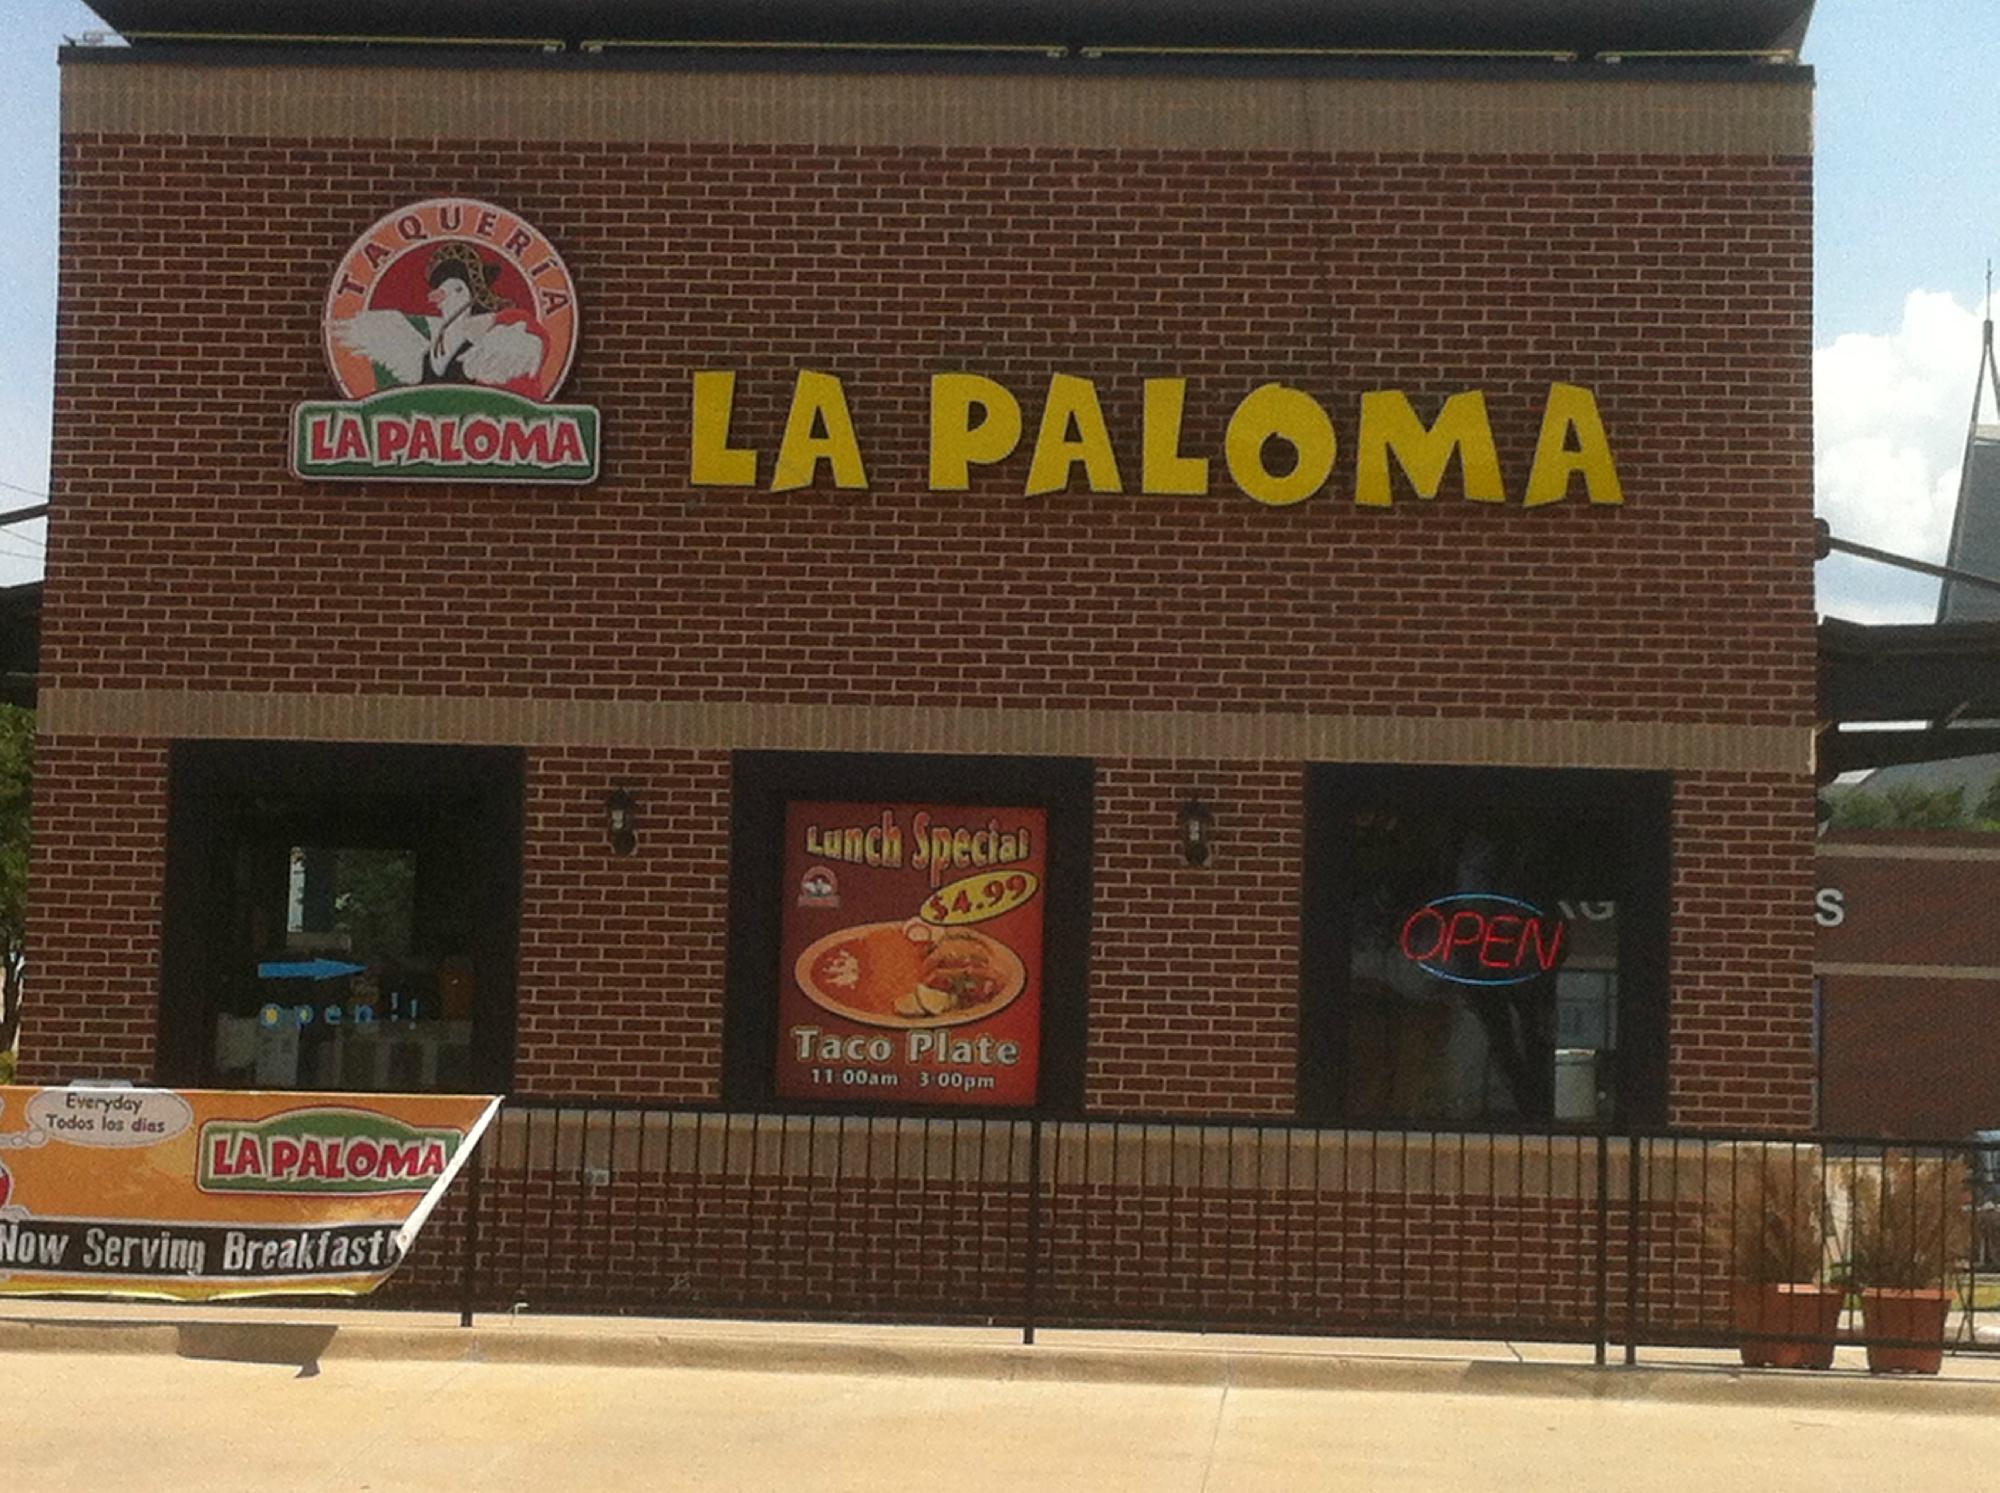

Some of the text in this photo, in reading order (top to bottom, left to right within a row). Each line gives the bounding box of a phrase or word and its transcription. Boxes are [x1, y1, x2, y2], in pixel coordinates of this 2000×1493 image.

[309, 415, 587, 466] LA PALOMA
[691, 370, 1624, 507] LA PALOMA
[806, 809, 1030, 888] Lunch Special
[929, 874, 1028, 921] $4.99
[1401, 908, 1563, 970] OPEN
[794, 1028, 1020, 1064] Taco Plate
[46, 1114, 94, 1130] Todos
[102, 1115, 124, 1131] los
[66, 1093, 142, 1114] Everyday
[212, 1138, 447, 1179] LA PALOMA
[0, 1223, 70, 1265] Now
[84, 1228, 205, 1274] Serving
